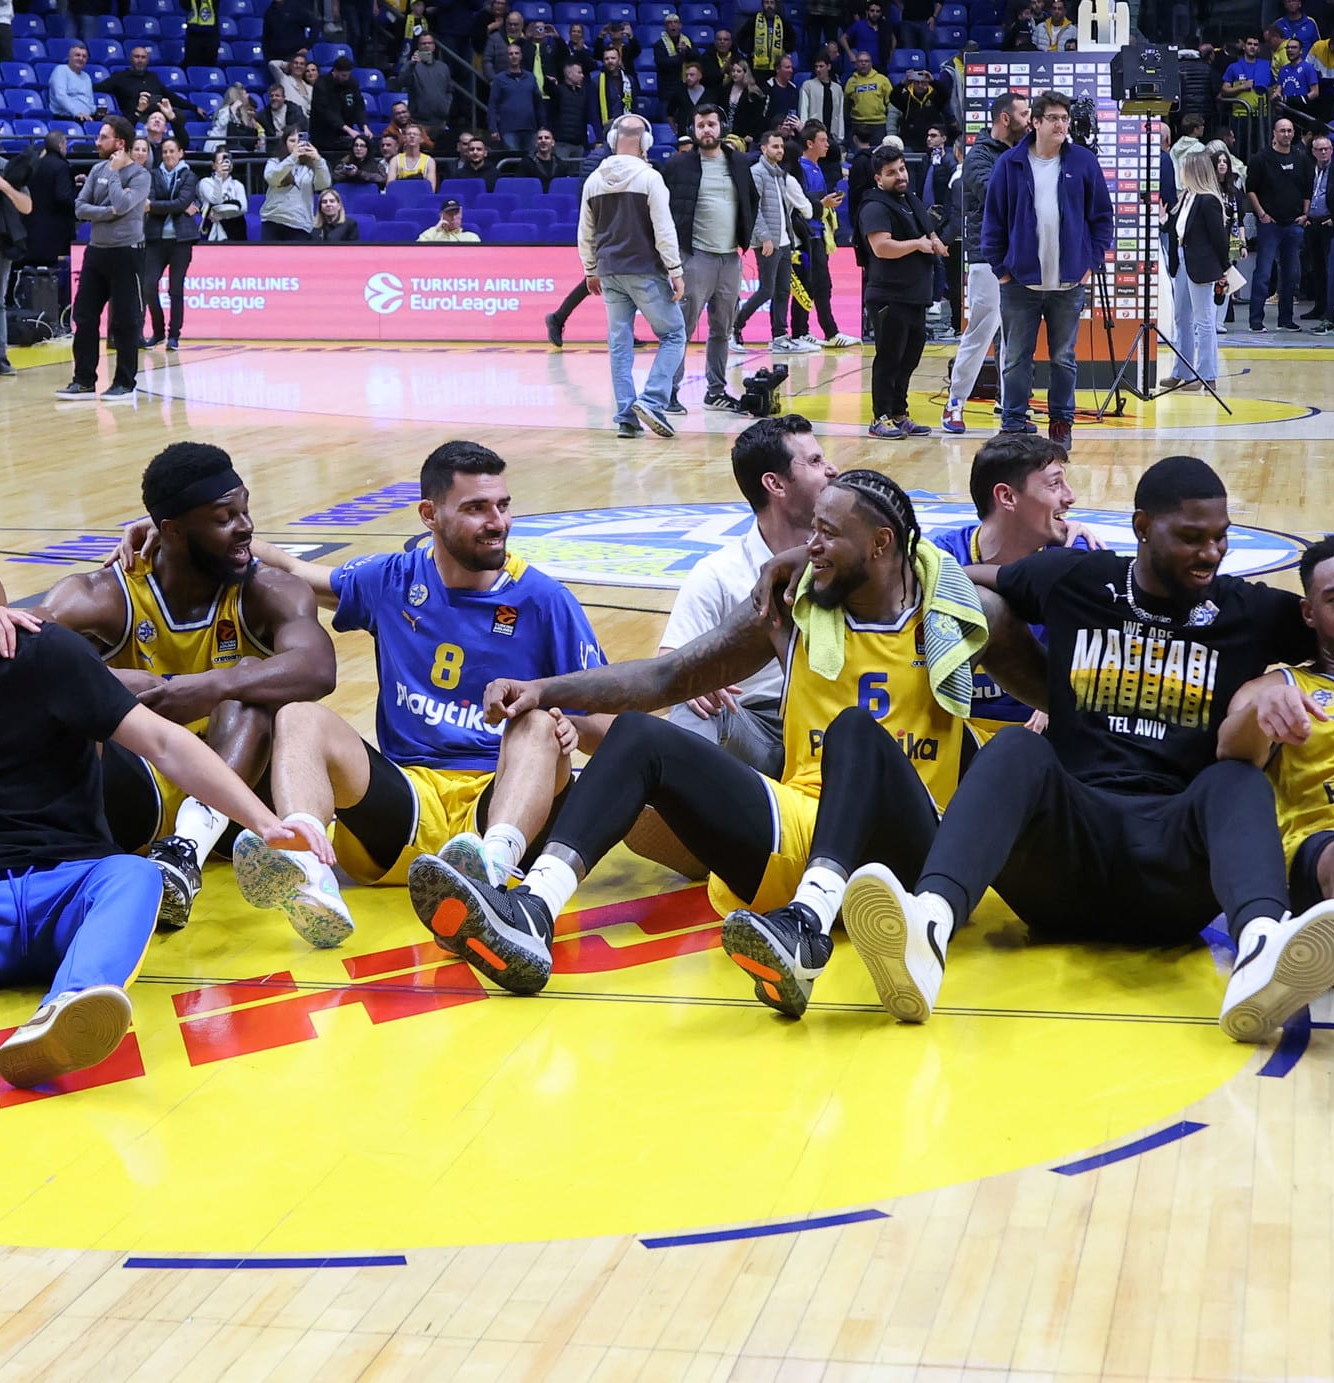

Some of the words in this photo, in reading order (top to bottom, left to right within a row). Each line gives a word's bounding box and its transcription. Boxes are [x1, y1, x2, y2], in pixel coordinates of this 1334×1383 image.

[160, 277, 226, 290] TRKISH
[230, 277, 299, 291] AIRLINES
[411, 278, 481, 291] TURKISH
[484, 278, 554, 292] AIRLINES
[410, 294, 519, 315] EuroLeague
[1123, 620, 1144, 636] WE
[430, 642, 465, 690] 8
[1071, 629, 1220, 702] MACCABI
[858, 672, 890, 719] 6
[1108, 715, 1131, 734] TEL
[1134, 718, 1167, 741] AVIV
[810, 729, 939, 761] Pika
